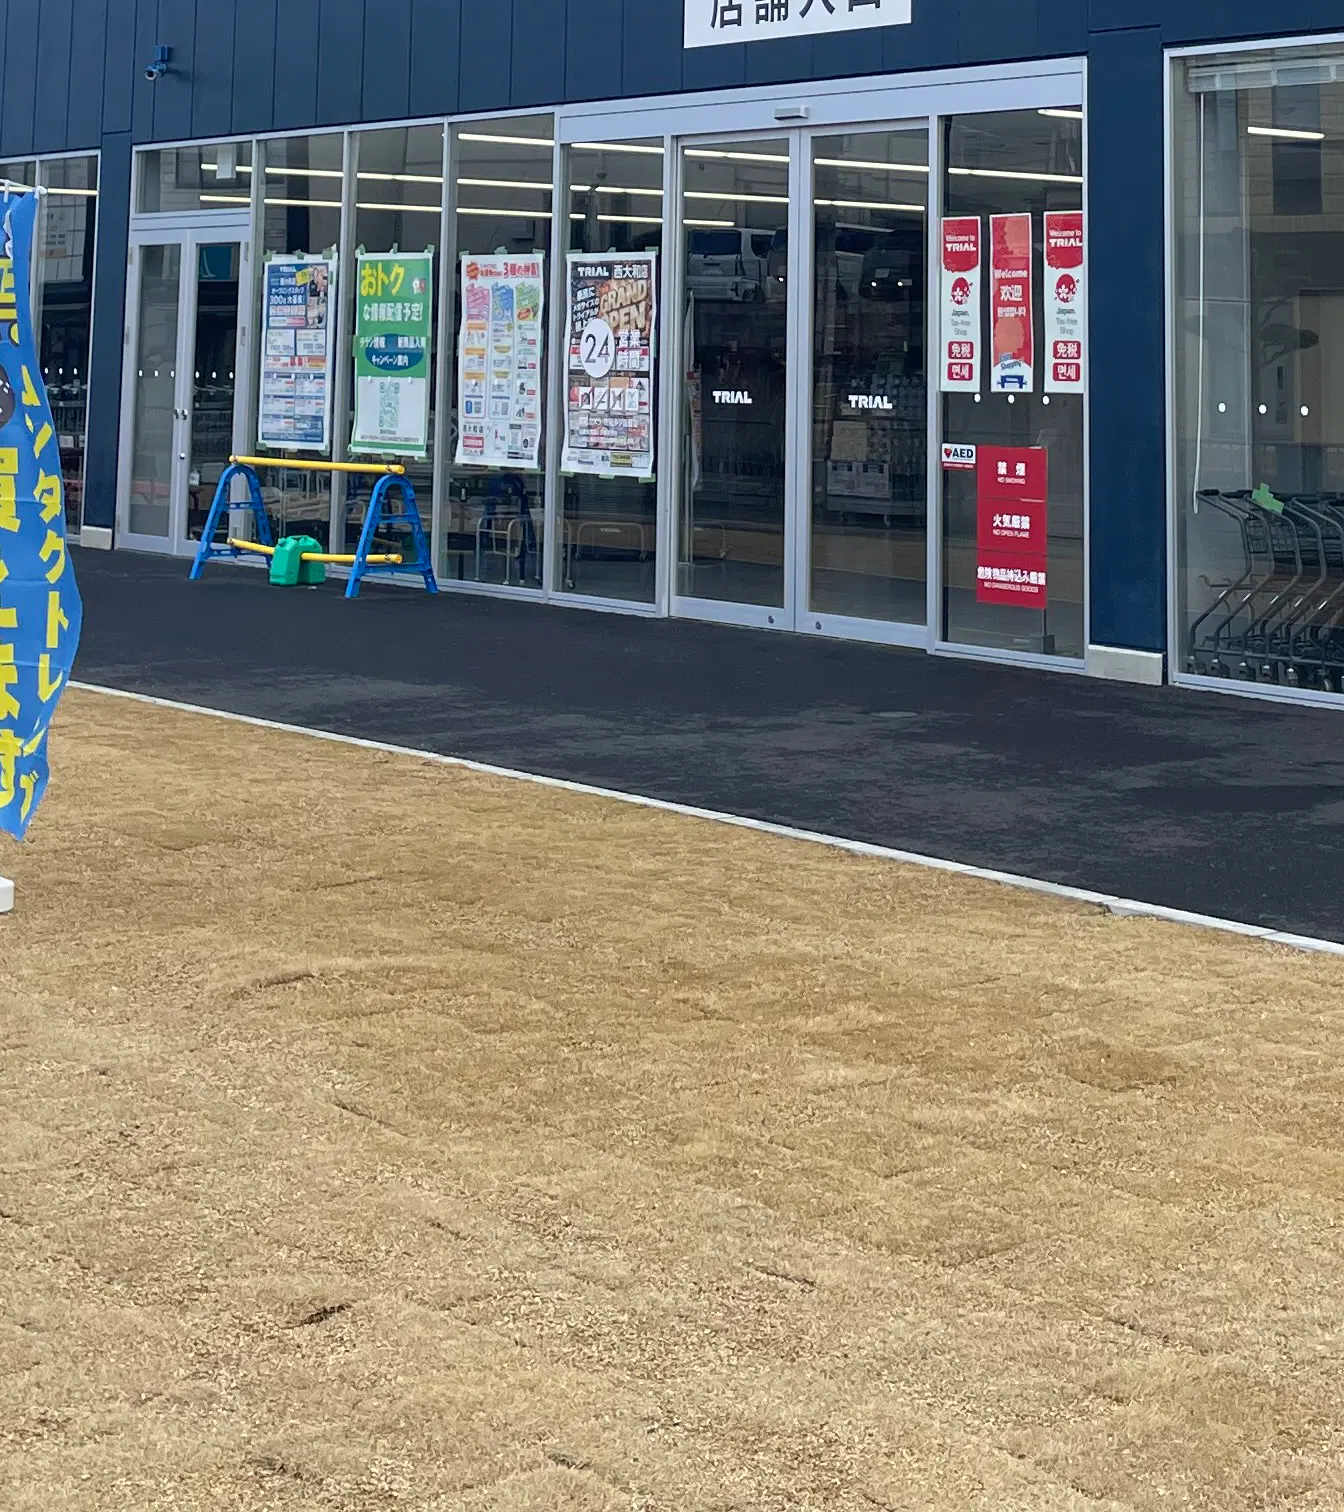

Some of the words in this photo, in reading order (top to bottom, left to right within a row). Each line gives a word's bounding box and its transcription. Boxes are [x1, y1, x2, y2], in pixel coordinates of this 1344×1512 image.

[946, 243, 977, 252] TRIAL
[1049, 238, 1083, 248] TRIAL
[577, 266, 610, 277] TRIAL
[994, 269, 1028, 279] Welcome
[360, 261, 405, 297] おトク
[600, 279, 648, 311] GRAND
[712, 390, 753, 404] TRIAL
[848, 394, 893, 409] TRIAL
[952, 447, 974, 459] AED
